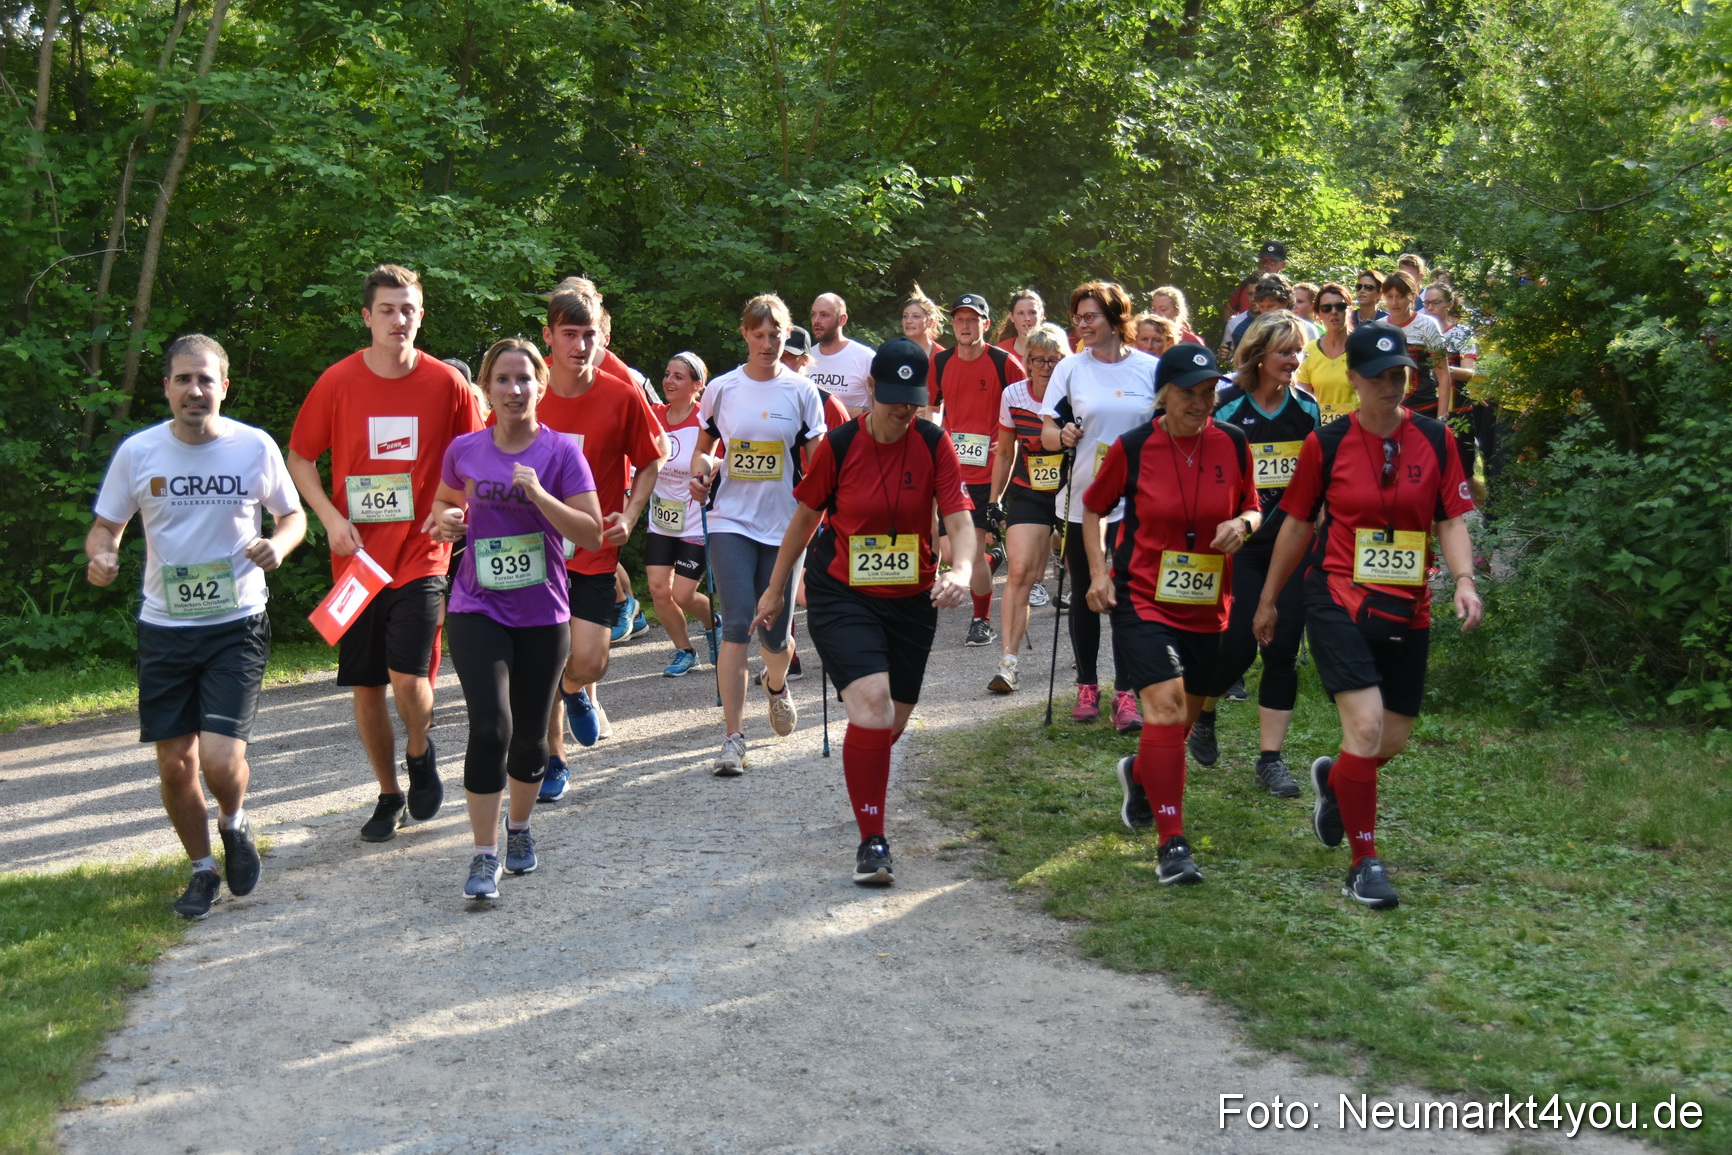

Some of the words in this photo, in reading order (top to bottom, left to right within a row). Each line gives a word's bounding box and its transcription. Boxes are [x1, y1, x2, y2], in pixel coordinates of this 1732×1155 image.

[810, 374, 848, 387] GRADL
[954, 443, 983, 457] 2346
[734, 453, 776, 470] 2379
[1257, 457, 1298, 476] 2183
[904, 471, 912, 485] 3
[1033, 467, 1060, 481] 226
[1215, 465, 1223, 478] 3
[1406, 464, 1422, 478] 13
[169, 475, 248, 497] GRADL
[361, 491, 399, 509] 464
[653, 504, 679, 524] 1902
[490, 554, 531, 576] 939
[857, 553, 909, 571] 2348
[1363, 549, 1416, 569] 2353
[1165, 570, 1214, 590] 2364
[178, 581, 221, 602] 942
[202, 598, 231, 606] Christoph
